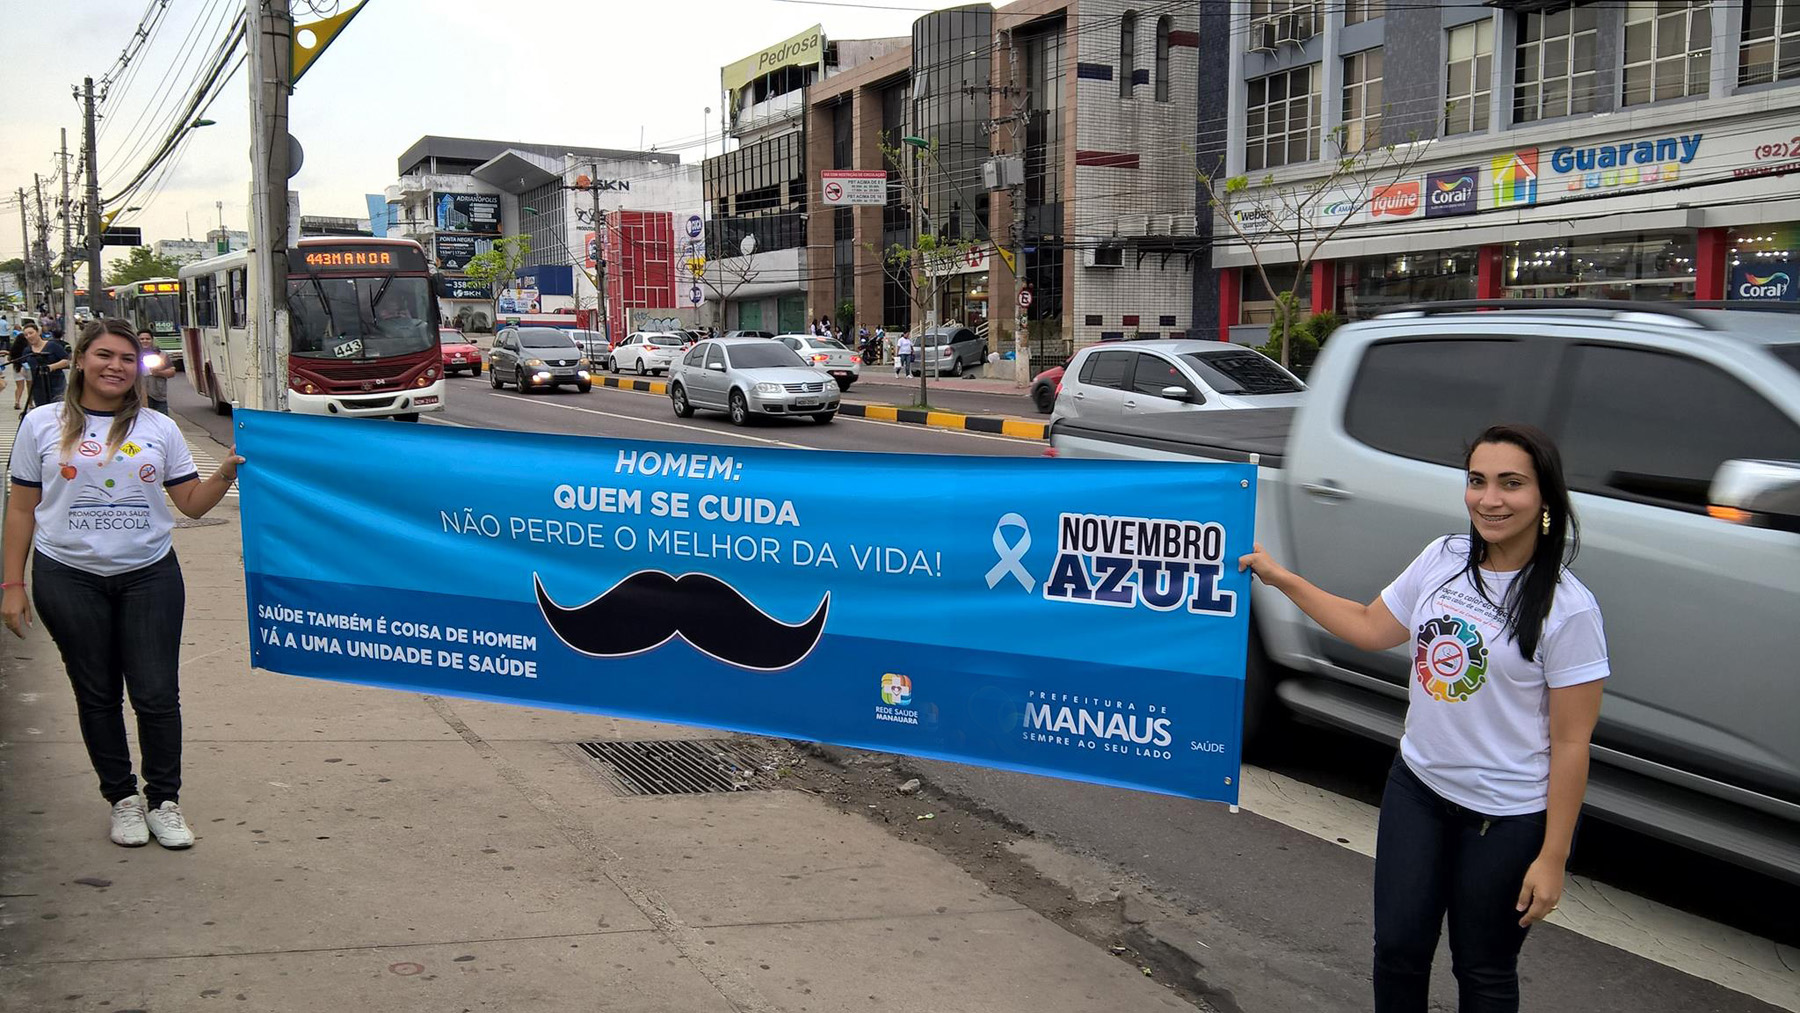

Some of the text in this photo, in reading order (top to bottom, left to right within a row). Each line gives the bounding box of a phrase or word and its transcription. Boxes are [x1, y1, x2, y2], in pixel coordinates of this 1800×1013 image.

[759, 34, 818, 70] Pedrosa
[1552, 134, 1703, 173] Guarany
[1755, 143, 1789, 160] (92)
[1432, 188, 1466, 204] Coral
[1740, 283, 1781, 297] Coral
[336, 341, 362, 357] 443
[615, 450, 743, 481] HOMEM:
[554, 484, 800, 527] QUEM SE CUIDA
[69, 518, 150, 530] NA ESCOLA
[1060, 515, 1223, 562] NOVEMBRO
[440, 507, 942, 577] NÃO PERDE O MELHOR DA VIDA!
[1045, 552, 1234, 614] AZUL
[258, 604, 537, 651] SAÚDE TAMBÉM É COISA DE HOMEM
[260, 626, 538, 679] VÁ A UMA UNIDADE DE SAÚDE
[875, 706, 893, 714] REDE
[1029, 690, 1167, 714] PREFEITURA DE
[876, 713, 918, 725] MANAUARA
[1023, 702, 1172, 747] MANAUS
[1023, 731, 1171, 760] SEMPRE AO SEU LADO
[1191, 740, 1225, 753] SAÚDE
